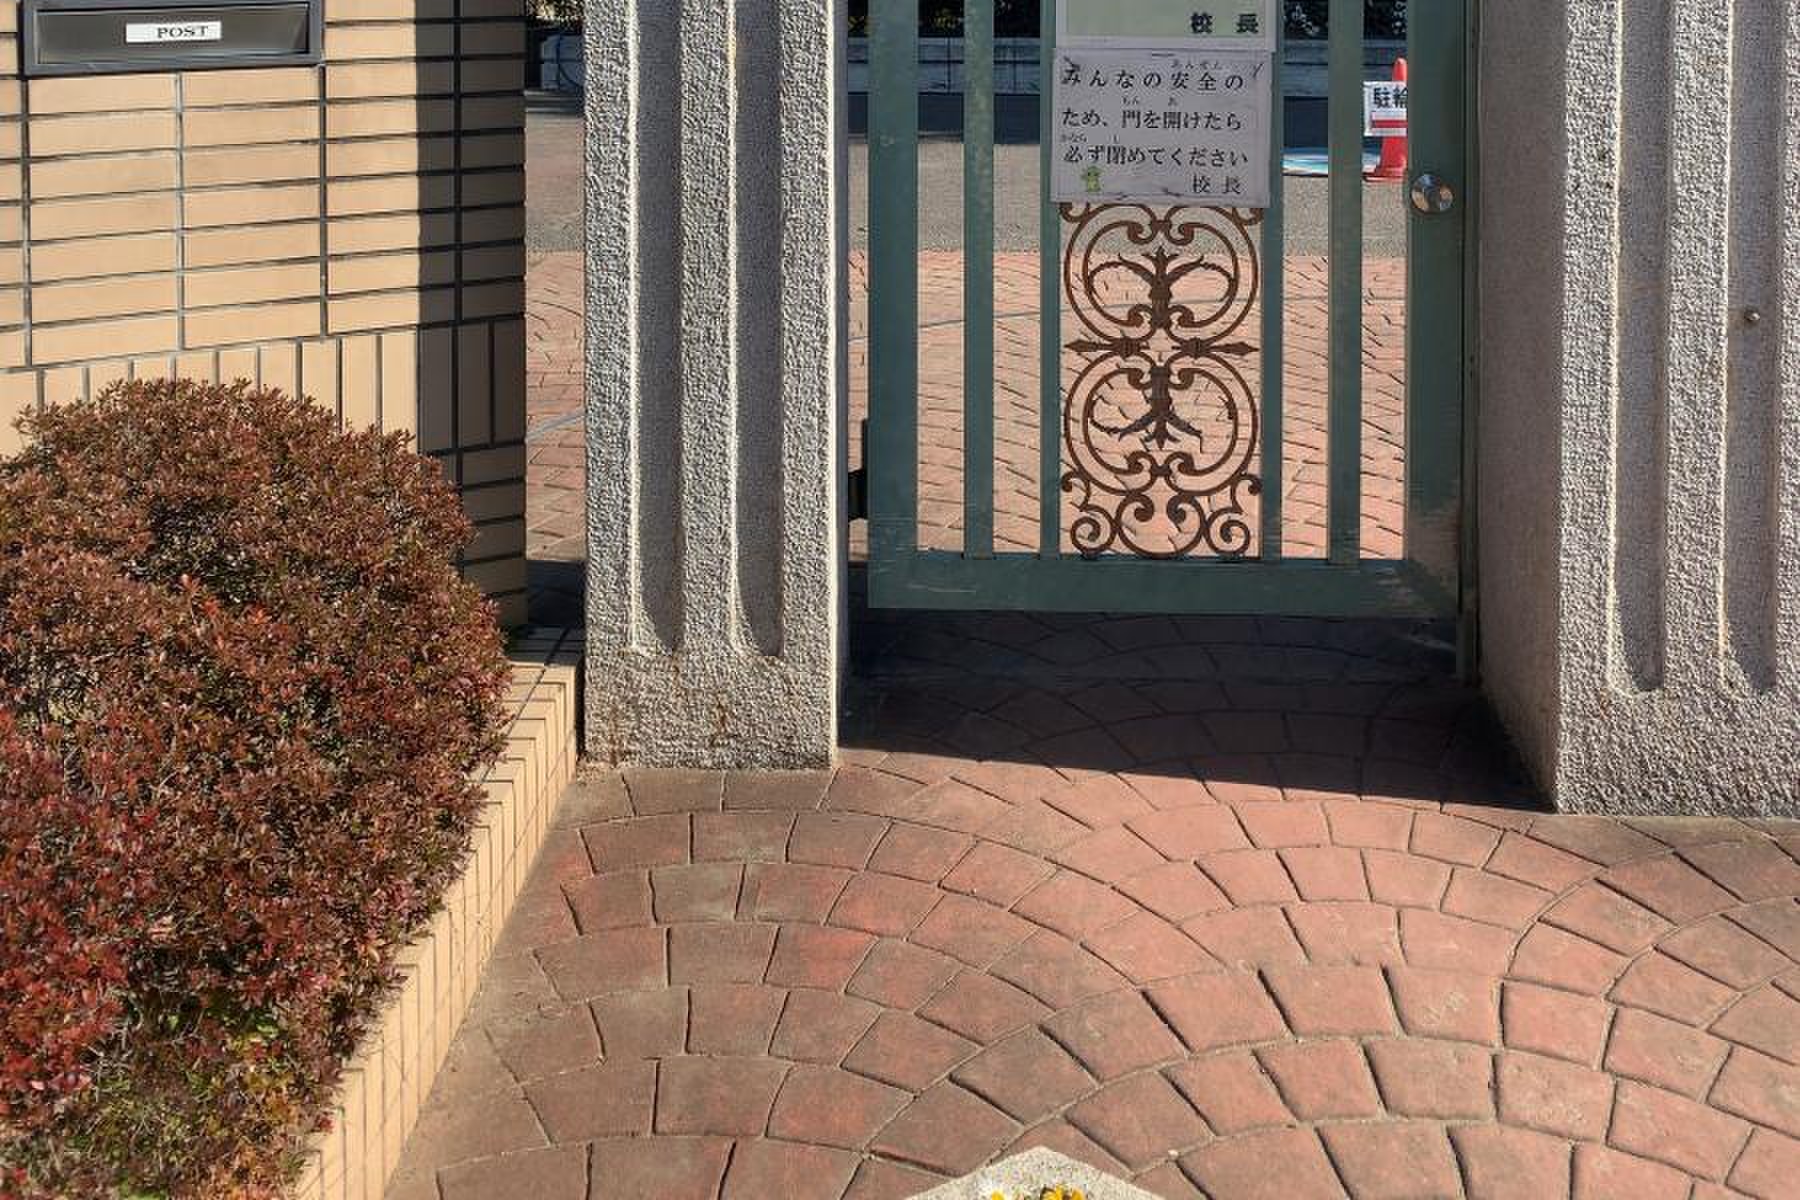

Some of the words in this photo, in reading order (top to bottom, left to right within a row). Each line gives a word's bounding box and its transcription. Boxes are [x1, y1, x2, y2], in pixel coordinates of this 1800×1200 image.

[157, 26, 208, 38] POST
[1062, 68, 1244, 92] みんなの安全の
[1062, 109, 1242, 130] ため、門を開けたら
[1063, 145, 1249, 168] 必ず閉めてください
